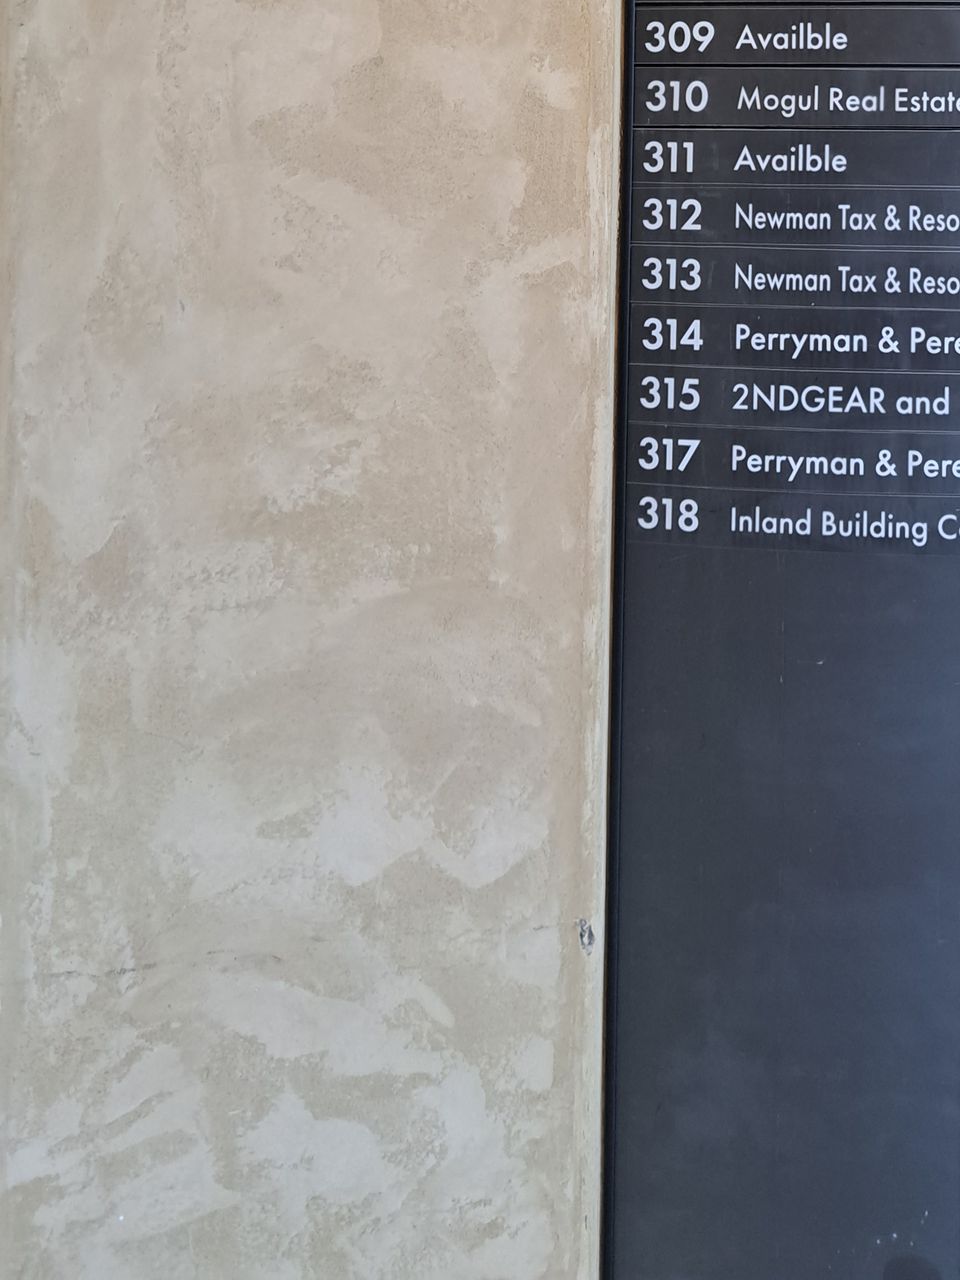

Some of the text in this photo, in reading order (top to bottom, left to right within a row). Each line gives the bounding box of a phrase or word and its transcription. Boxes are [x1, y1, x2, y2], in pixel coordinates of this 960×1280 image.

[644, 20, 848, 54] 309 Availble
[645, 79, 709, 113] 310
[736, 84, 820, 119] Mogul
[828, 85, 885, 113] Real
[642, 140, 848, 174] 311 Availble
[641, 197, 702, 231] 312
[734, 202, 832, 231] Newman
[837, 203, 878, 231] Tax
[883, 204, 902, 232] &
[641, 256, 702, 292] 313
[734, 262, 832, 292] Newman
[837, 265, 878, 293] Tax
[883, 266, 902, 294] &
[641, 316, 704, 352] 314
[735, 323, 868, 360] Perryman
[877, 325, 901, 354] &
[639, 375, 701, 411] 315
[731, 382, 887, 415] 2NDGEAR
[895, 385, 950, 416] and
[637, 436, 702, 472] 317
[731, 444, 865, 483] Perryman
[874, 448, 898, 477] &
[636, 495, 700, 533] 318
[730, 505, 812, 536] Inland
[821, 509, 928, 548] Building
